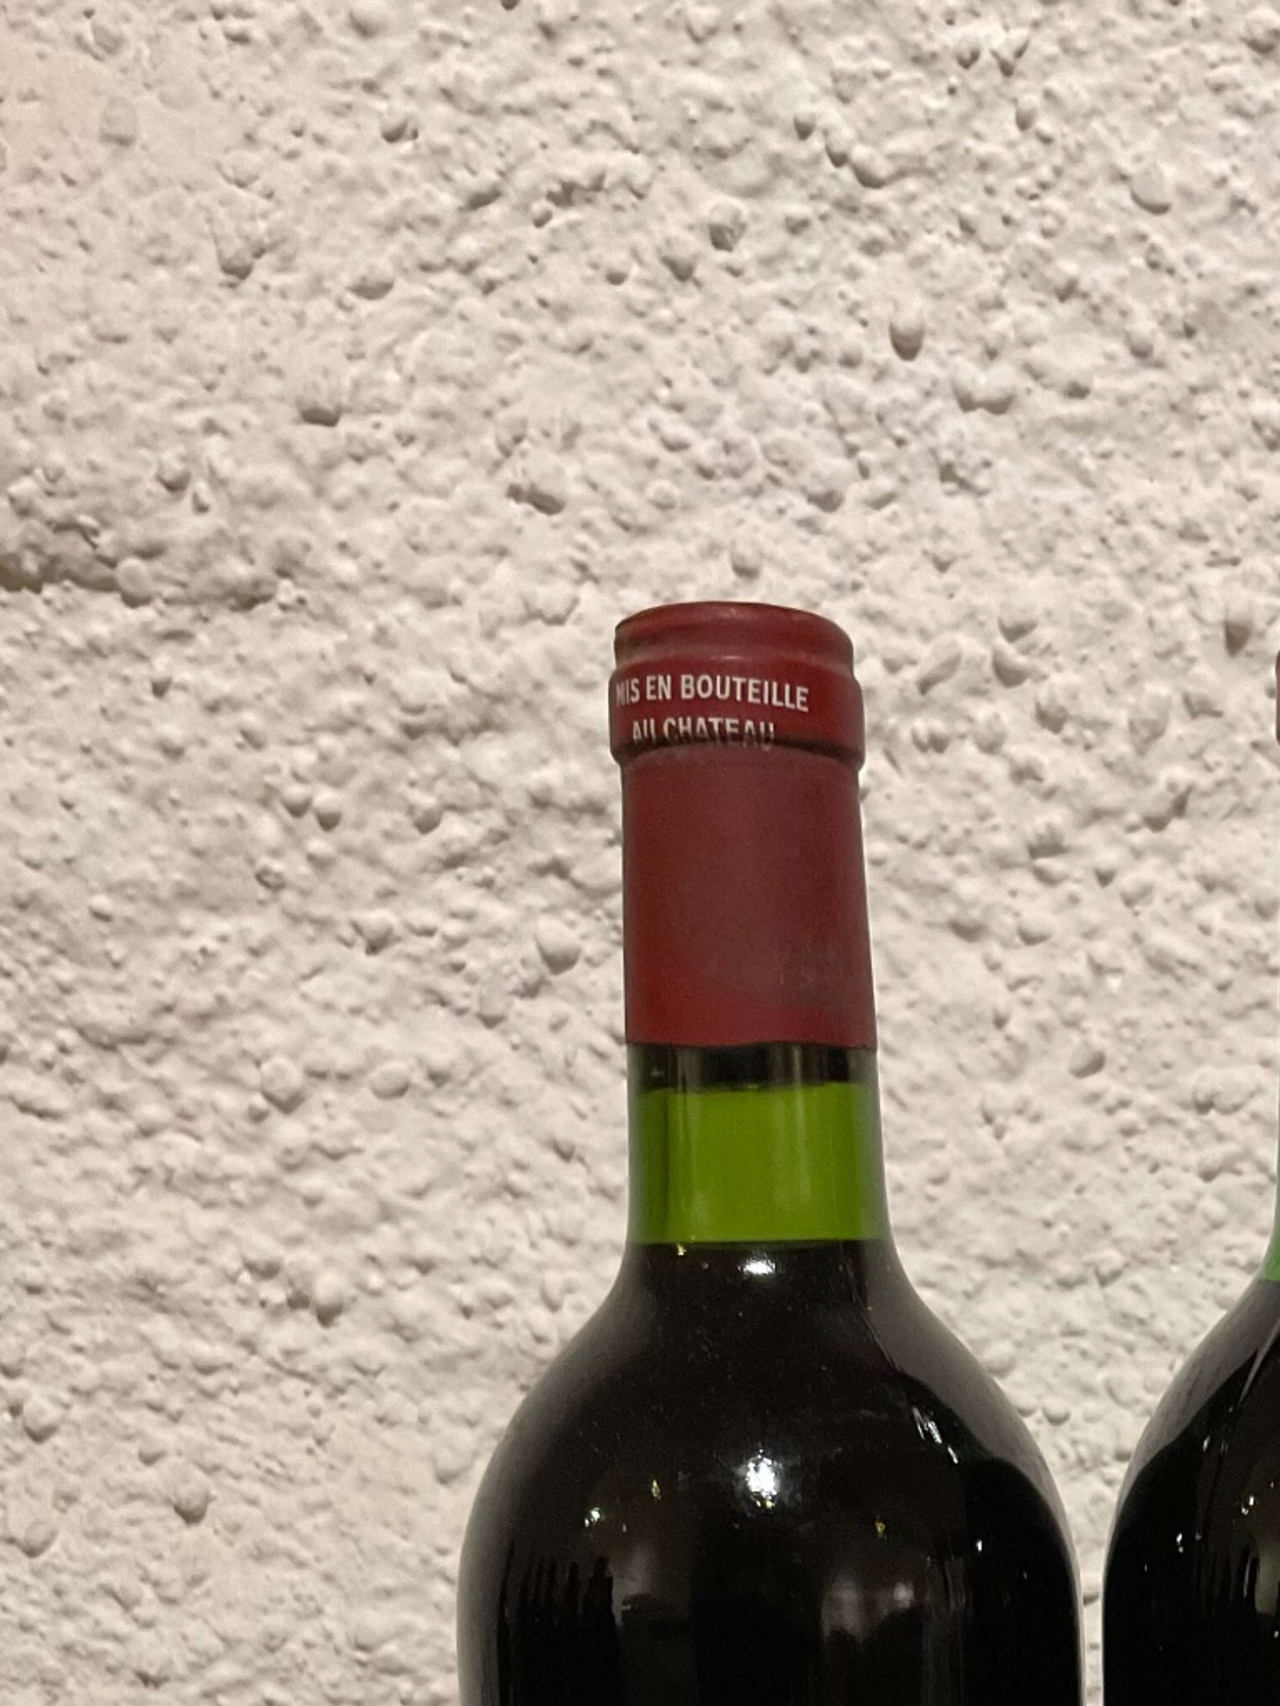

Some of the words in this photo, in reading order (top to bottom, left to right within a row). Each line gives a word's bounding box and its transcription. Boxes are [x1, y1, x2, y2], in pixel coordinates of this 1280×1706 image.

[615, 677, 640, 708] MIS
[645, 674, 672, 700] EN
[680, 673, 810, 713] BOUTEILLE
